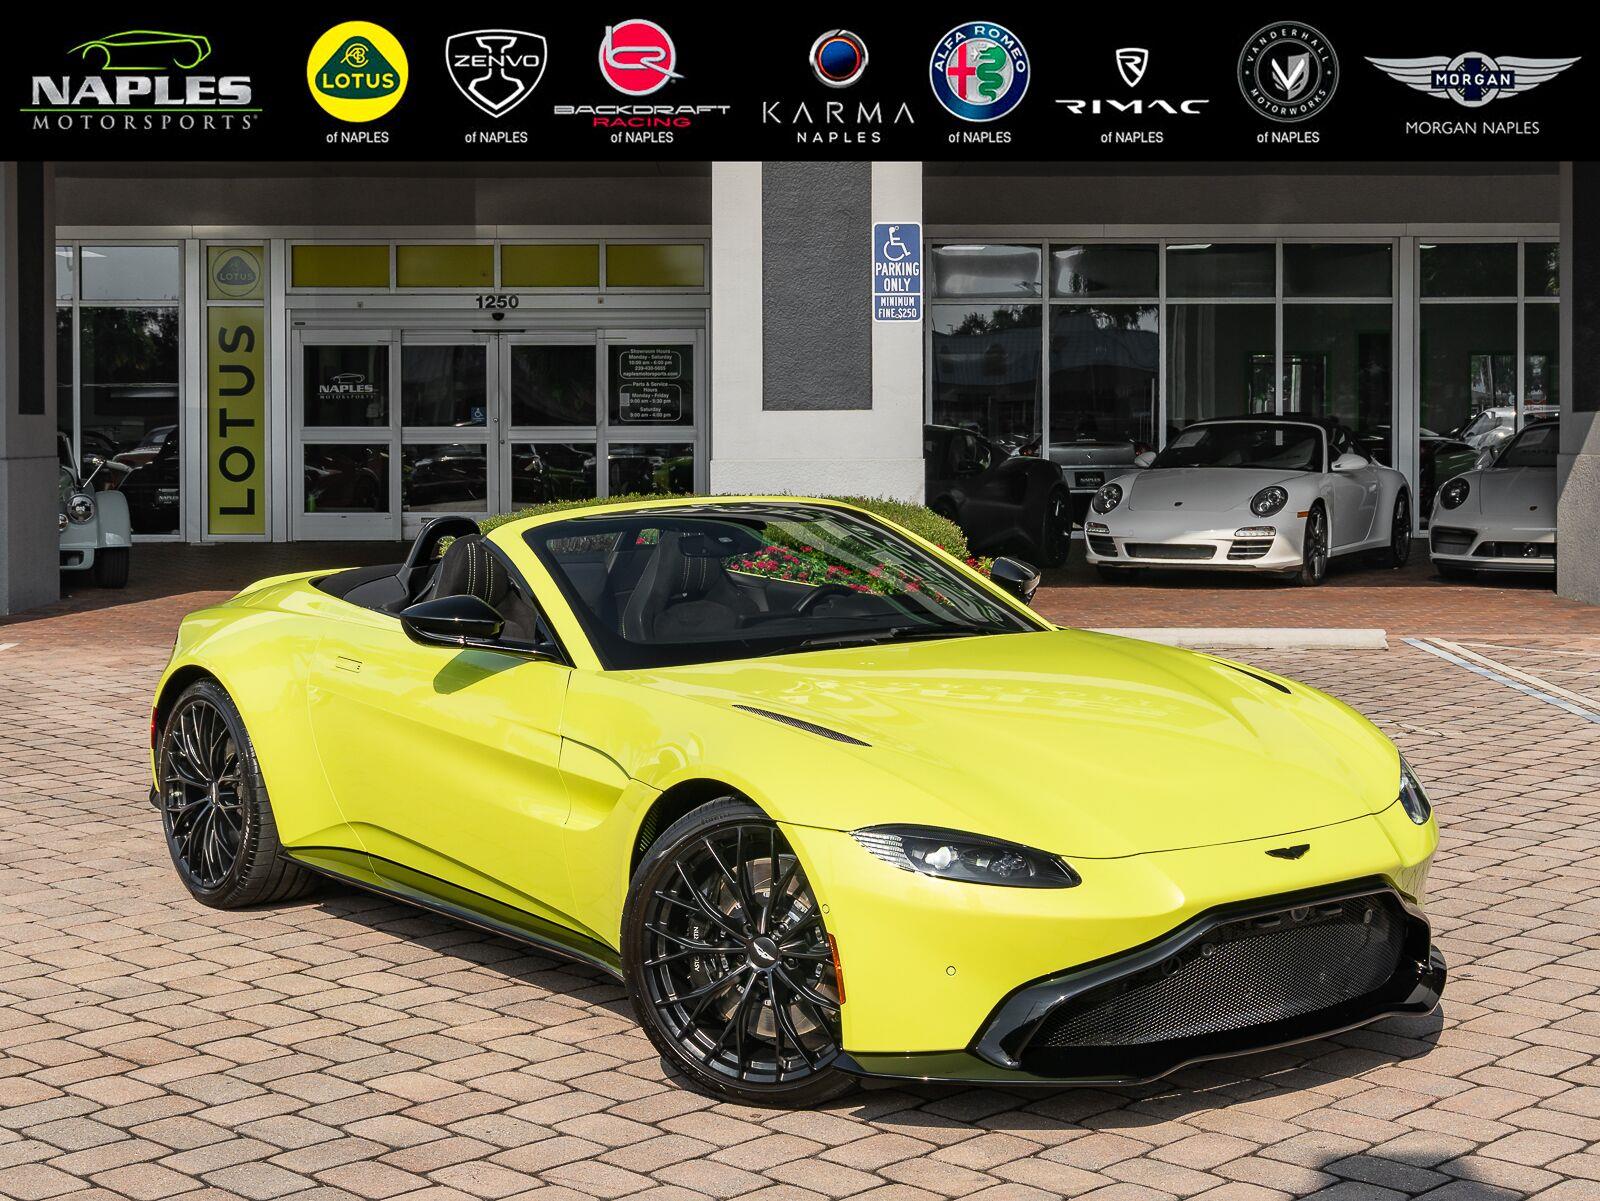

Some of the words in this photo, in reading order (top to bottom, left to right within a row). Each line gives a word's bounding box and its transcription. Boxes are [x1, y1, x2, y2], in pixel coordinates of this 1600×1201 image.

[875, 262, 920, 276] PARKING
[220, 272, 255, 281] LOTUS
[883, 278, 911, 292] ONLY
[475, 294, 519, 309] 1250
[880, 296, 915, 307] MINIMUM
[878, 308, 896, 318] FINE
[897, 307, 917, 319] $250
[320, 384, 374, 393] NAPLES
[218, 324, 256, 516] LOTUS
